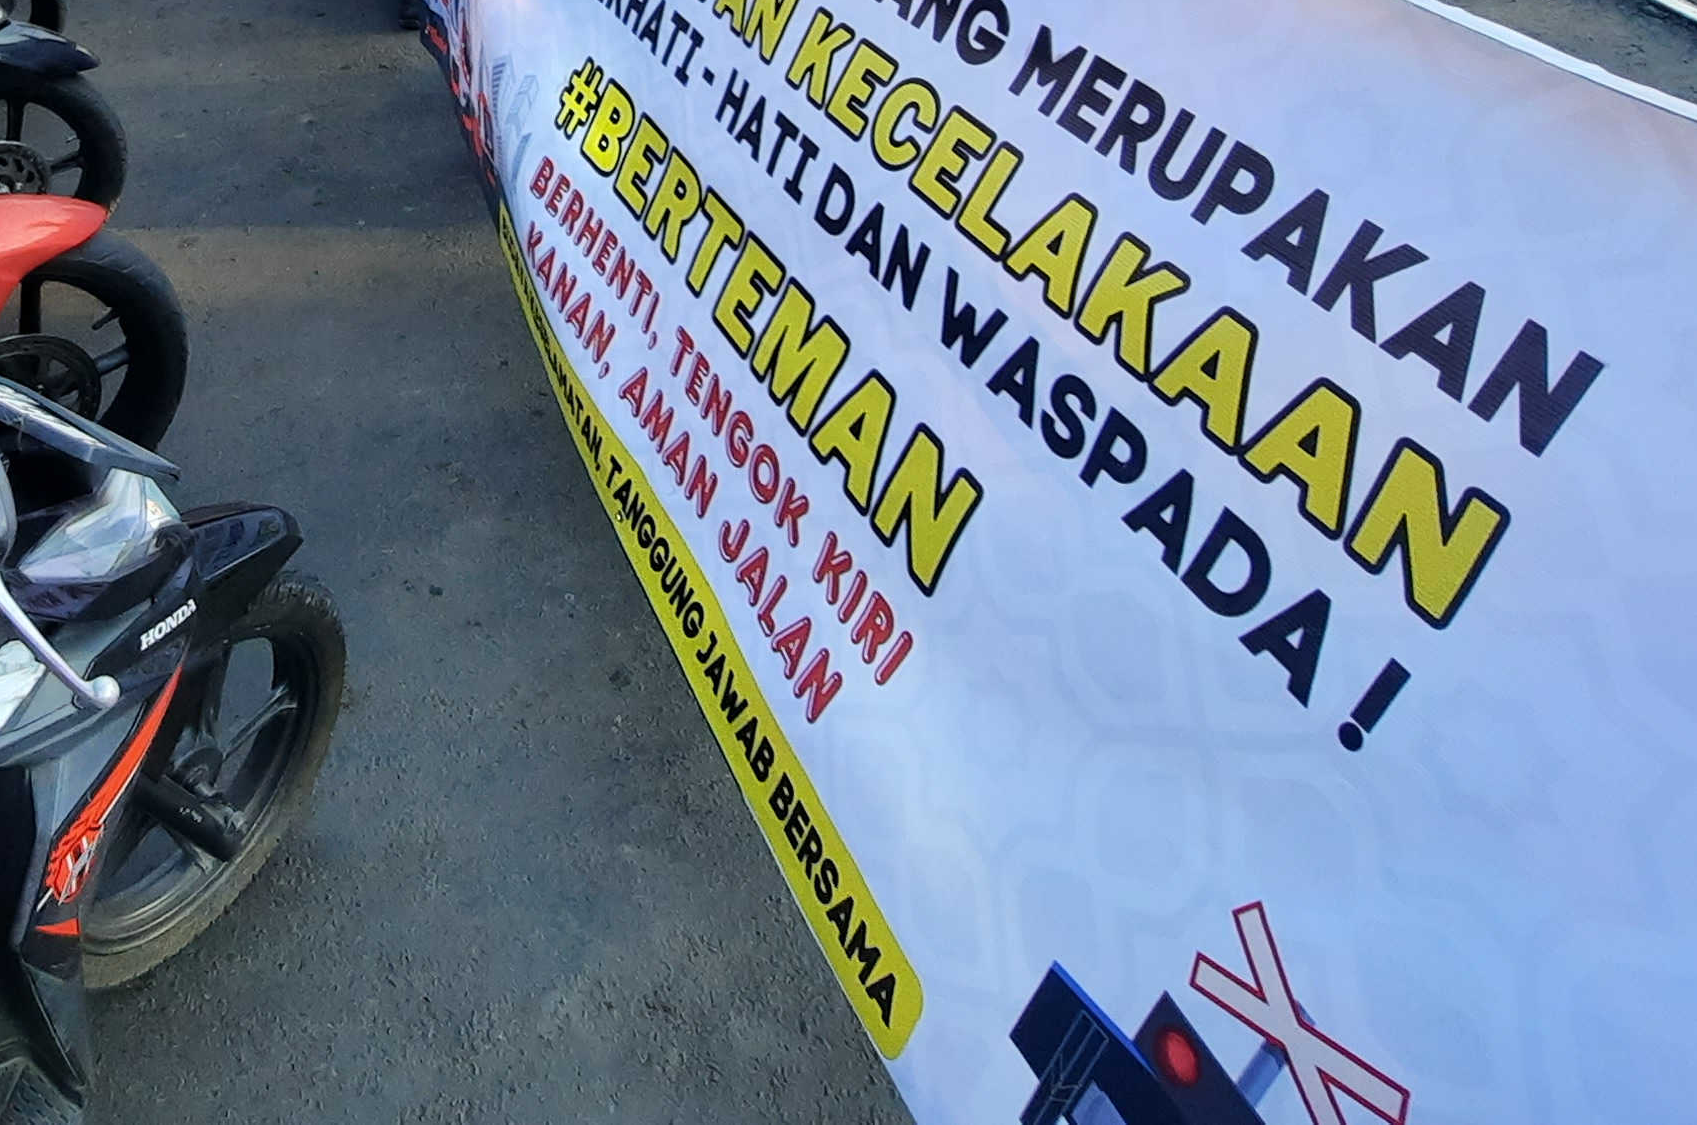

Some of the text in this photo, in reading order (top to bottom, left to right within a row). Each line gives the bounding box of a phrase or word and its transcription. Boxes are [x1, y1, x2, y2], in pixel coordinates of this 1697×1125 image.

[525, 220, 843, 724] KANAN, AMAN JALAN
[528, 155, 914, 685] BERHENTI, TENGOK KIRI
[553, 53, 984, 597] #BERTEMAN
[785, 5, 1511, 631] KECELAKAAN
[813, 162, 932, 312] DAN
[940, 264, 1333, 709] WASPADA
[1007, 24, 1606, 458] MERUPAKAN
[140, 598, 197, 651] HONDA
[605, 454, 705, 640] TANGGUNG
[694, 629, 776, 783] JAWAB
[767, 770, 901, 1030] BERSAMA
